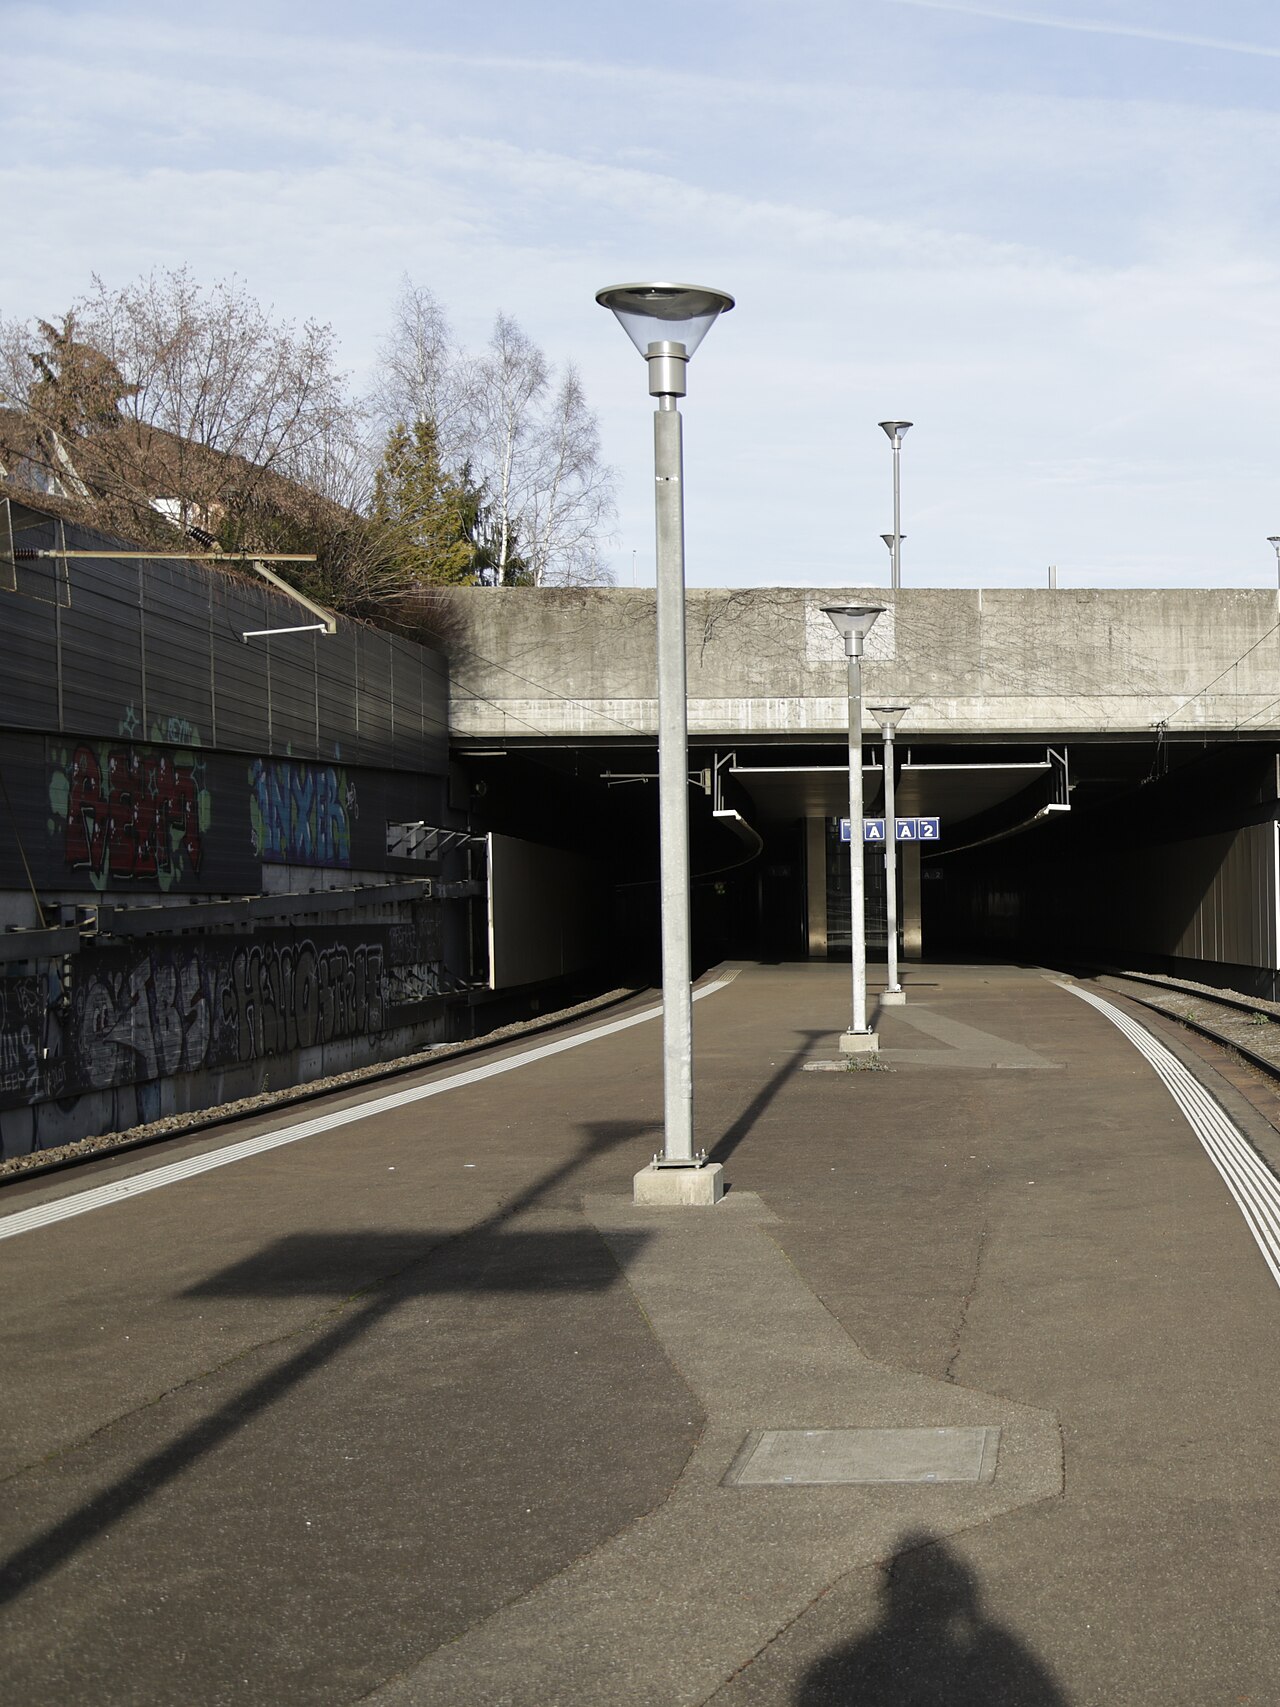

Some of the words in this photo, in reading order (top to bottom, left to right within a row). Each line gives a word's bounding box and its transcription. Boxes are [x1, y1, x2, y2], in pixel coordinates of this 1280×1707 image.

[869, 825, 880, 838] A
[900, 825, 912, 838] A
[923, 825, 933, 837] 2
[935, 871, 941, 879] 2
